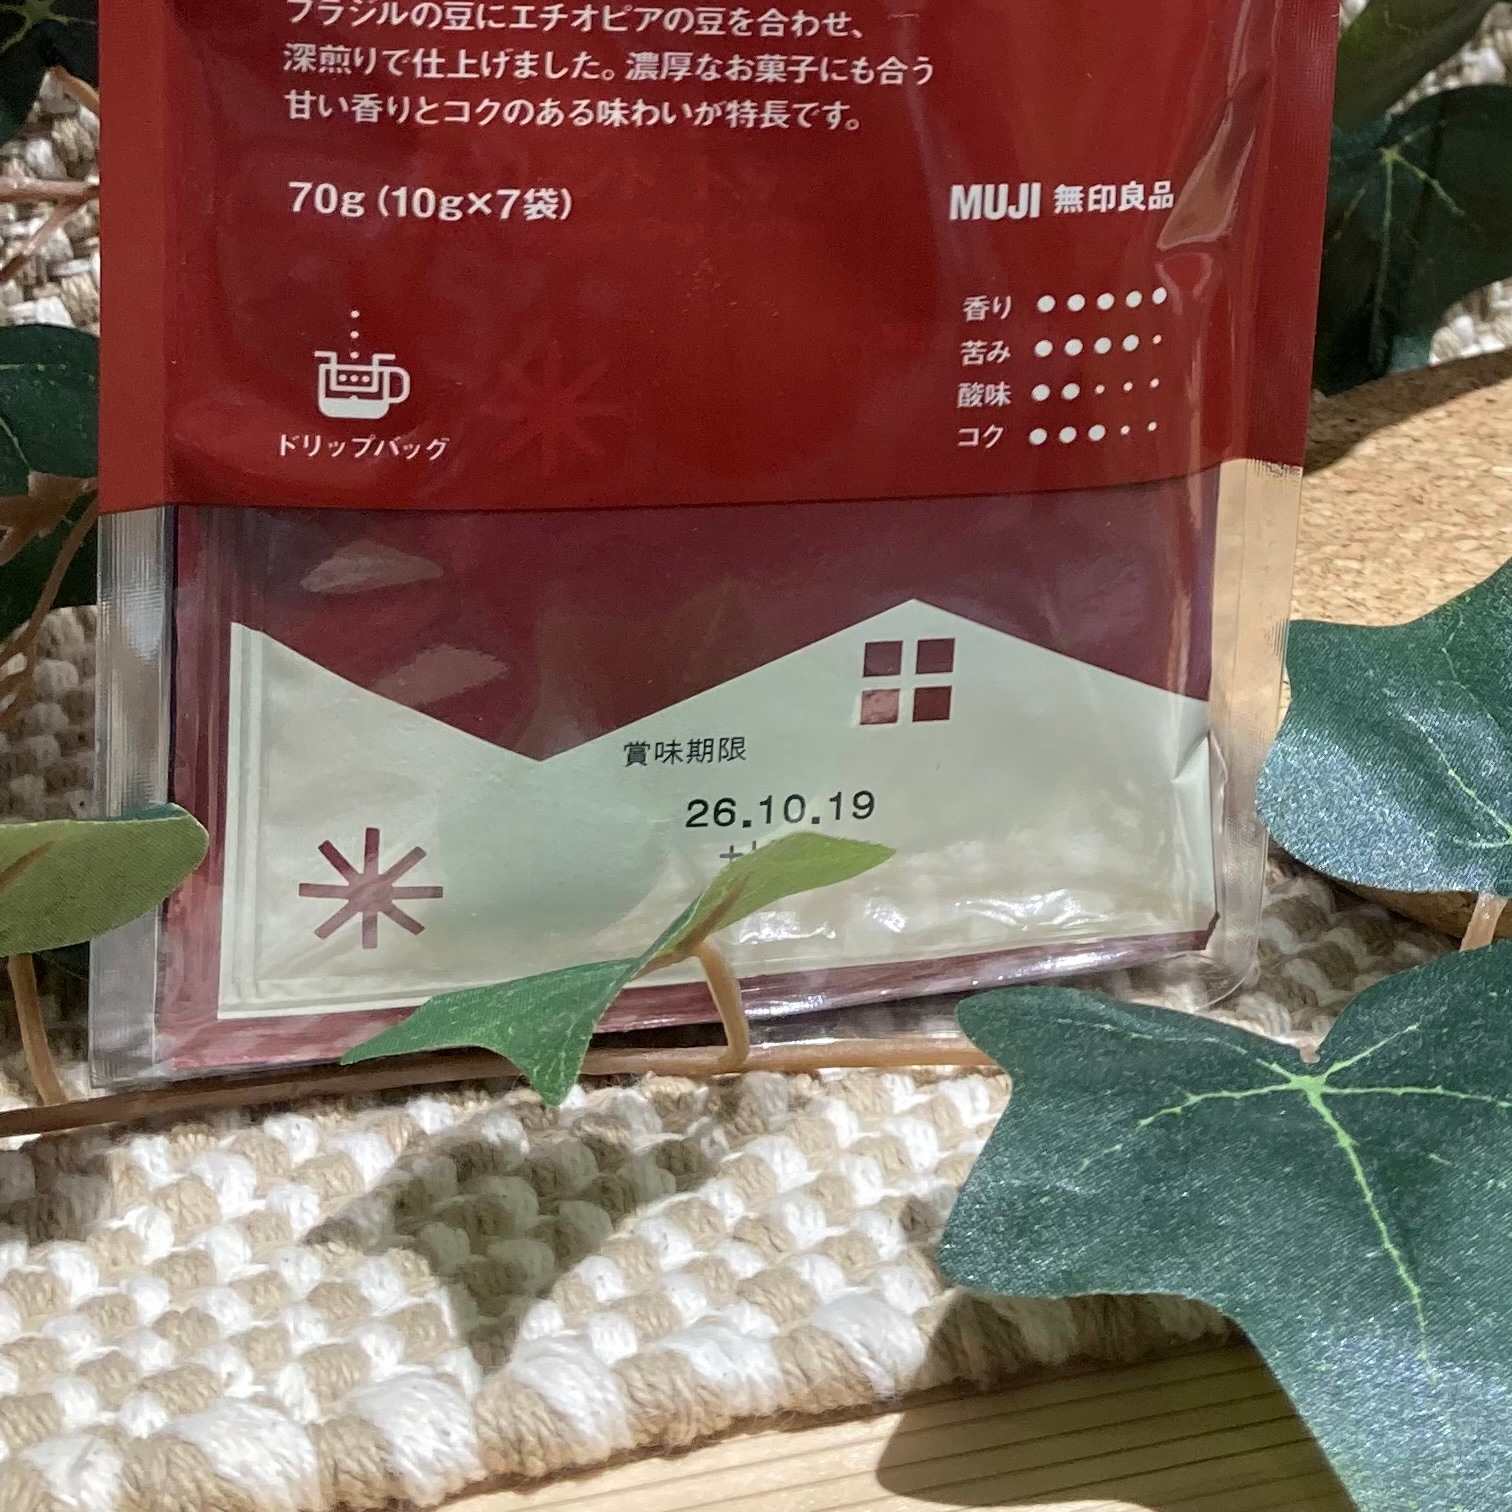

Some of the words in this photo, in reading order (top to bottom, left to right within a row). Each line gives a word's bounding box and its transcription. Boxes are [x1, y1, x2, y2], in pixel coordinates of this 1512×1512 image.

[283, 43, 934, 85] 深煎りで仕上げました。濃厚なお菓子にも合う
[284, 89, 860, 131] 甘い香りとコクのある味わいが特長です。
[288, 181, 366, 218] 70g
[949, 182, 1042, 221] MUJI
[1053, 180, 1175, 215] 無印良品
[963, 294, 1012, 322] 香り
[960, 339, 1012, 366] 苦み
[957, 381, 1012, 409] 酸味
[280, 433, 450, 461] ドリップバッグ
[957, 423, 1005, 449] コク
[623, 736, 747, 768] 賞味期限
[685, 790, 875, 828] 26.10.19
